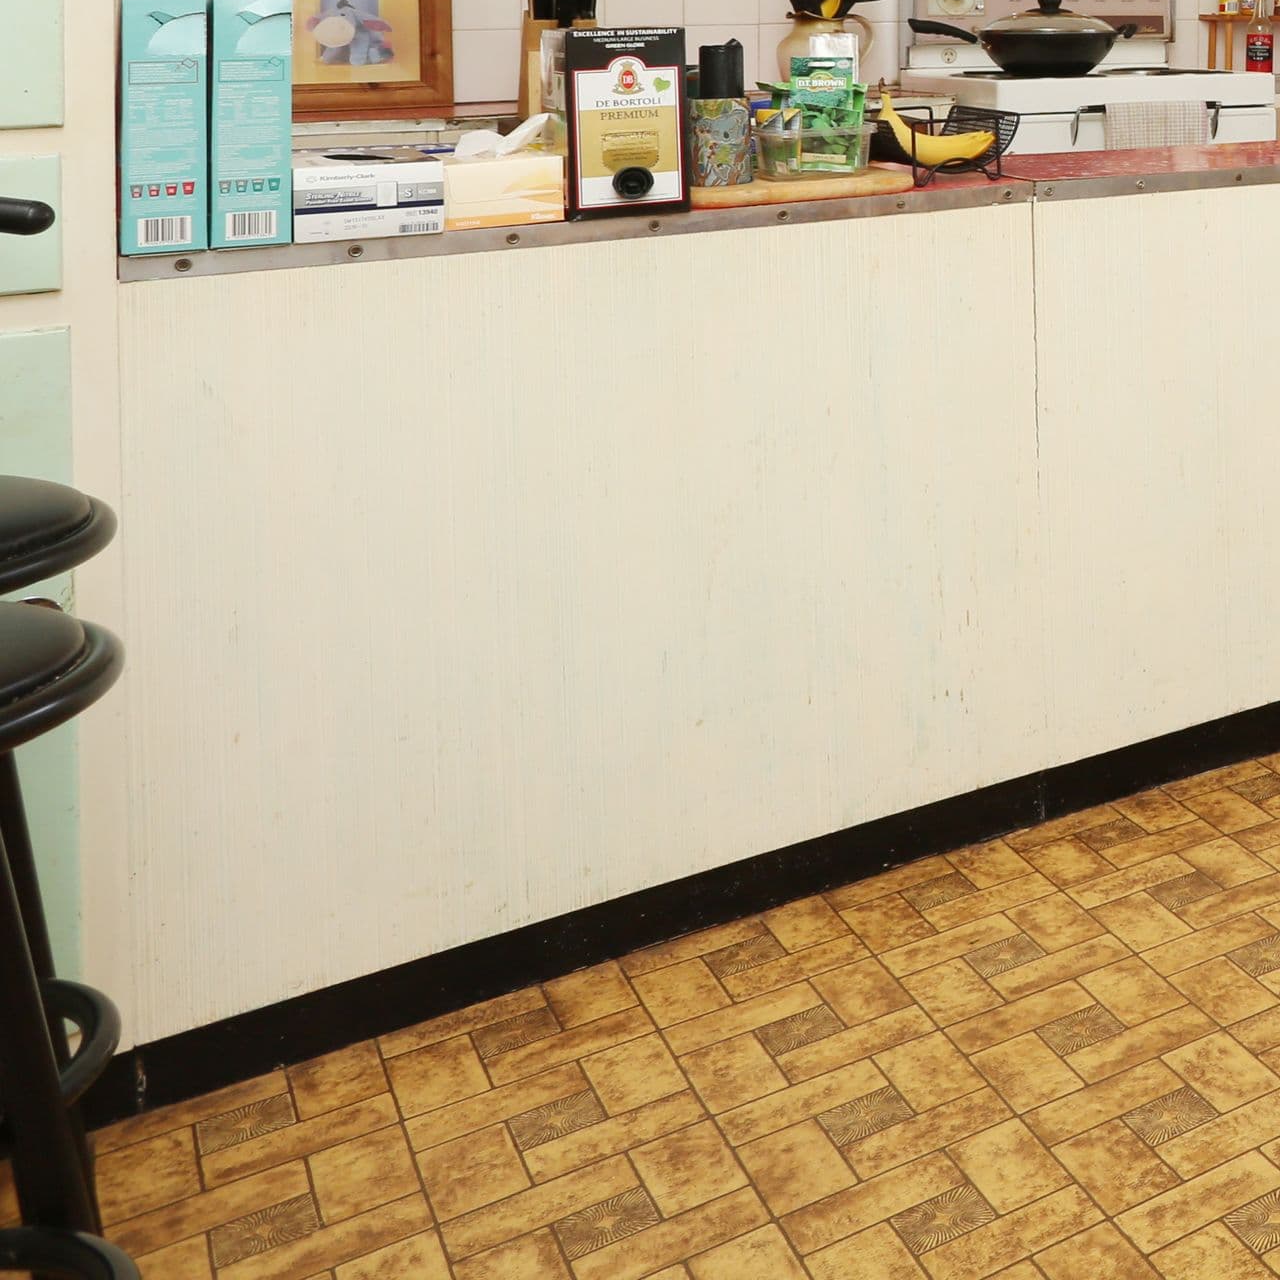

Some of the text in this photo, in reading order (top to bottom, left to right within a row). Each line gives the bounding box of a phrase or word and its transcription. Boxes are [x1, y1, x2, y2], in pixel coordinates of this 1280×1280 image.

[573, 30, 615, 38] EXCELLENCE
[626, 28, 678, 36] SUSTAINABILITY
[623, 75, 634, 84] DB
[596, 97, 661, 108] DE BORTOLI
[600, 109, 659, 120] PREMIUM
[320, 173, 375, 182] Kimberly-Clark
[404, 188, 413, 199] S
